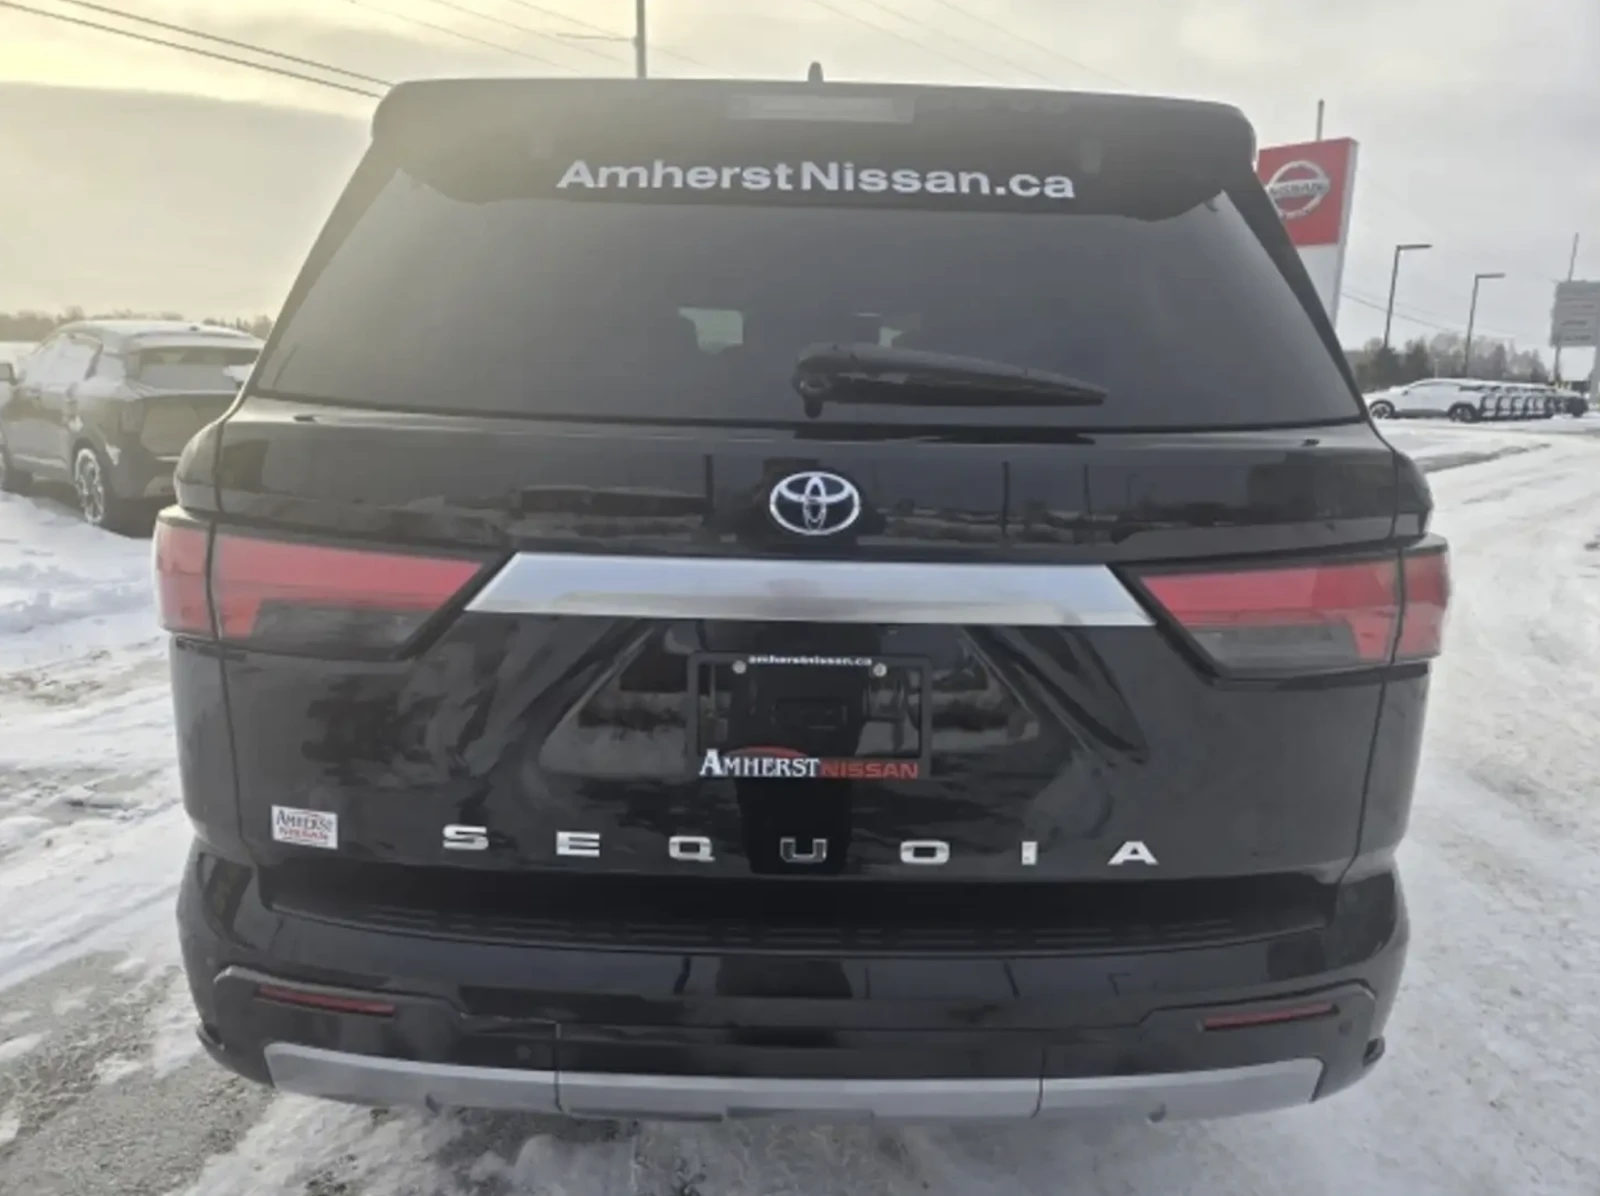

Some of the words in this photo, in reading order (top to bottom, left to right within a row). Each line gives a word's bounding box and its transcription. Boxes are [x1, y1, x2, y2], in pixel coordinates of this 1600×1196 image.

[699, 748, 820, 779] AMHERST
[819, 760, 920, 780] NISSAN
[442, 824, 1160, 866] SEQUOIA
